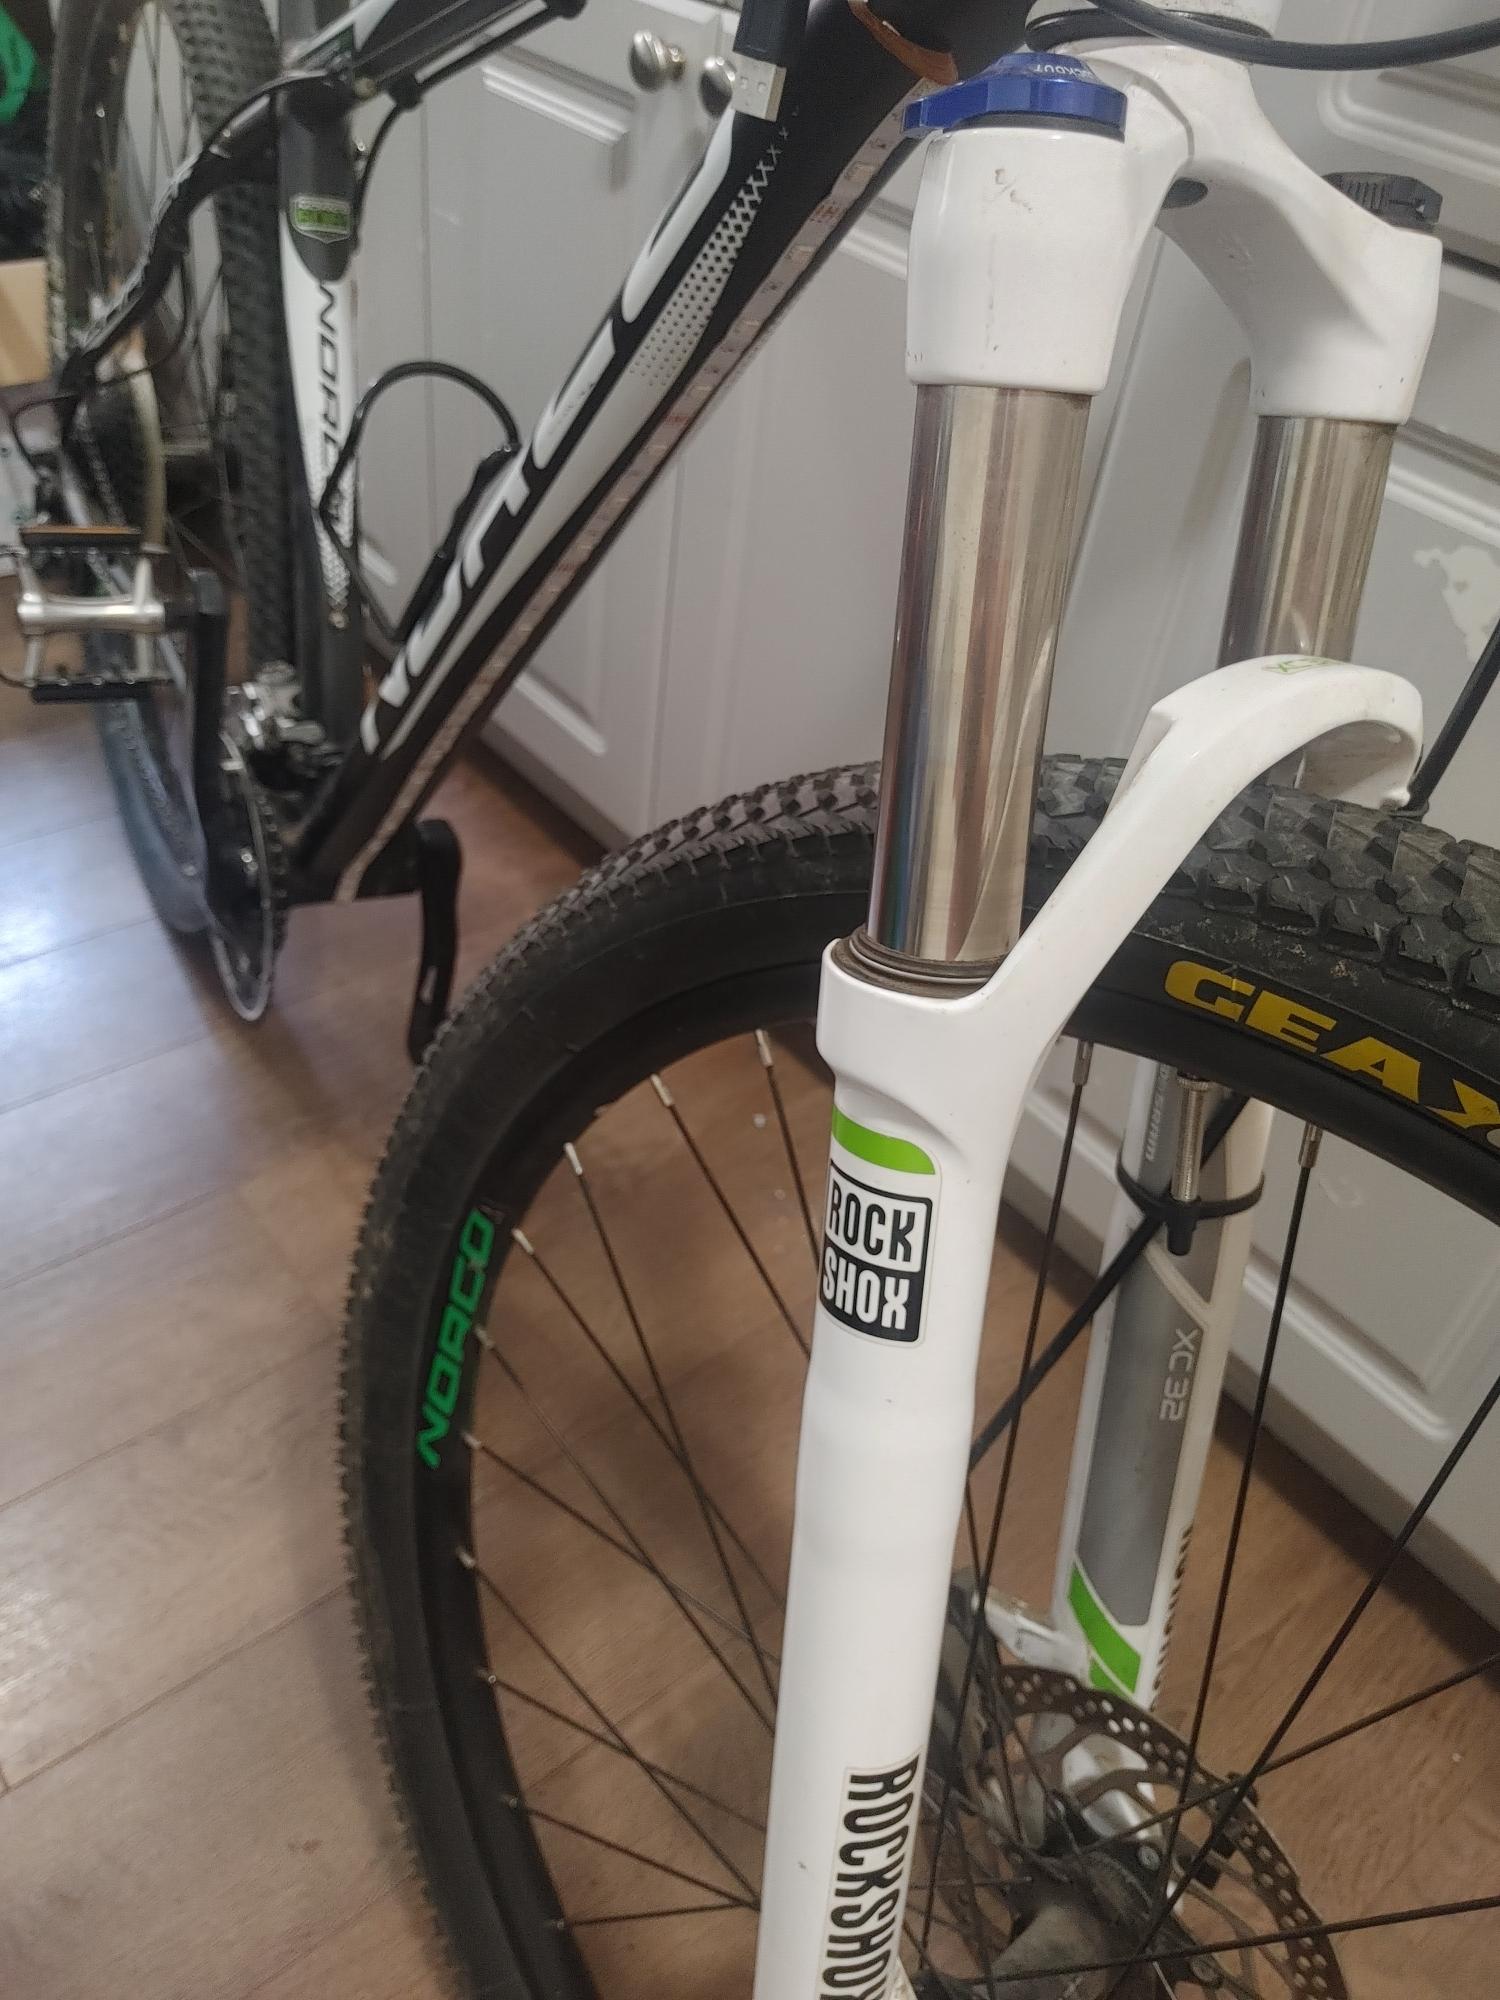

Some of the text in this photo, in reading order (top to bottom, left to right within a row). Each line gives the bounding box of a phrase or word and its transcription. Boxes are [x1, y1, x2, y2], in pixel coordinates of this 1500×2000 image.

[829, 1178, 916, 1263] ROCK
[822, 1246, 910, 1330] SHOX
[416, 1208, 495, 1468] NORCO
